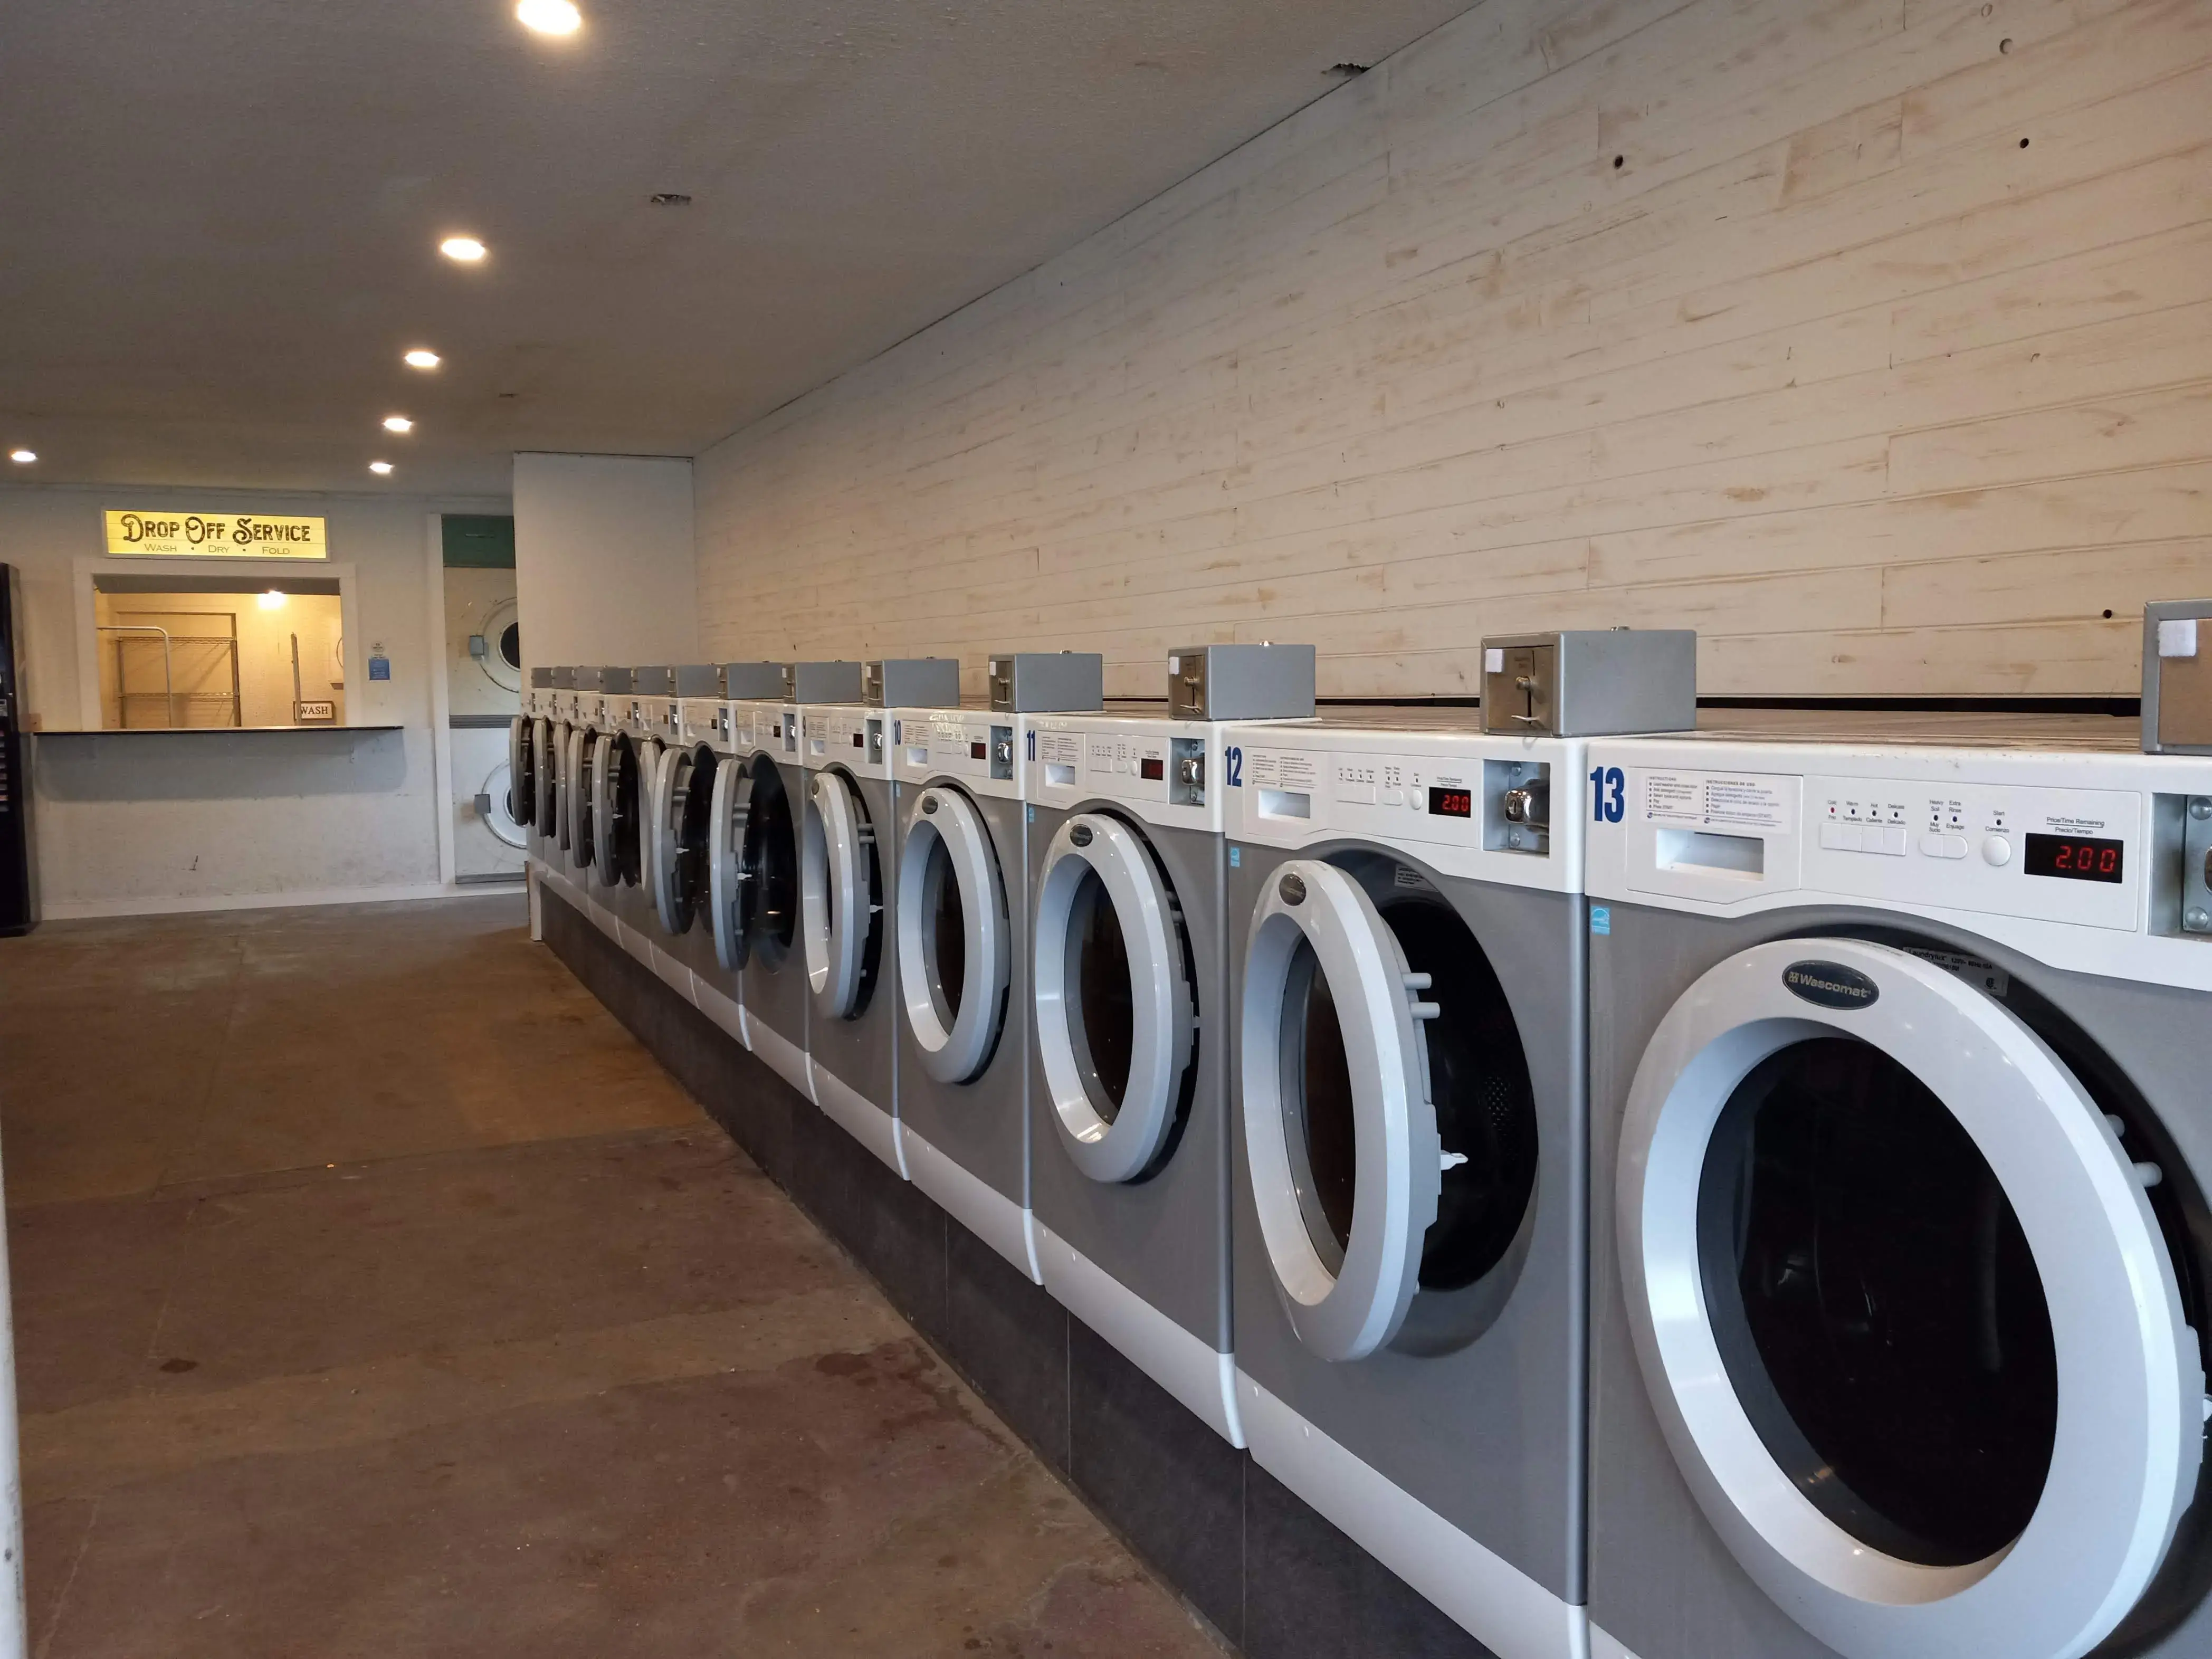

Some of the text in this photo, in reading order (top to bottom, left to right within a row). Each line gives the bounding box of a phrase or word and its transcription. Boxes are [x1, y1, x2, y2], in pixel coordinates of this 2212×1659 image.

[144, 544, 177, 552] WASH
[894, 720, 901, 745] 10
[1027, 730, 1035, 761] 11
[1225, 746, 1242, 787] 12
[1590, 766, 1624, 823] 13
[2076, 818, 2105, 827] Remaining
[1800, 974, 1868, 998] Wascomat
